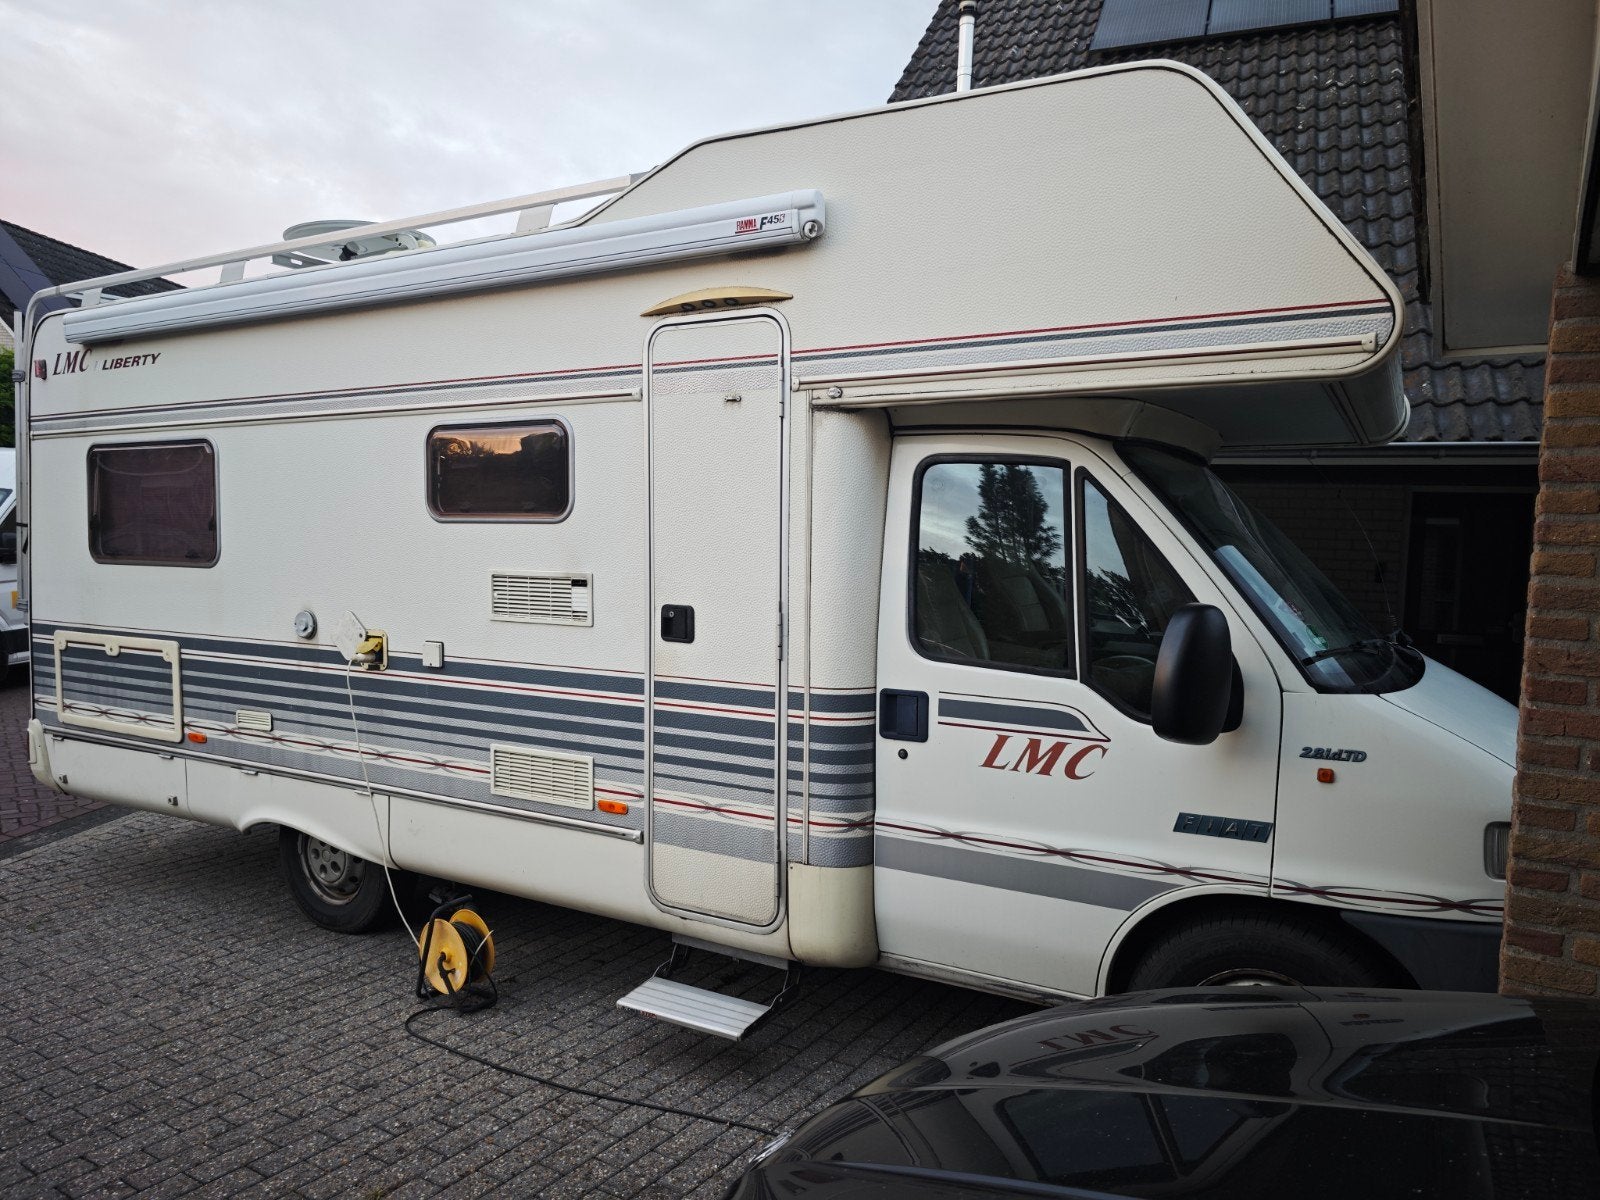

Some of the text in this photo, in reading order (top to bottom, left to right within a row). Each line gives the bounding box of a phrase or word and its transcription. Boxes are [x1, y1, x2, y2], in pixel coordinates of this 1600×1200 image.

[52, 348, 161, 376] LMC LIBERTY
[978, 733, 1110, 780] LMC
[1181, 814, 1268, 840] FIAT
